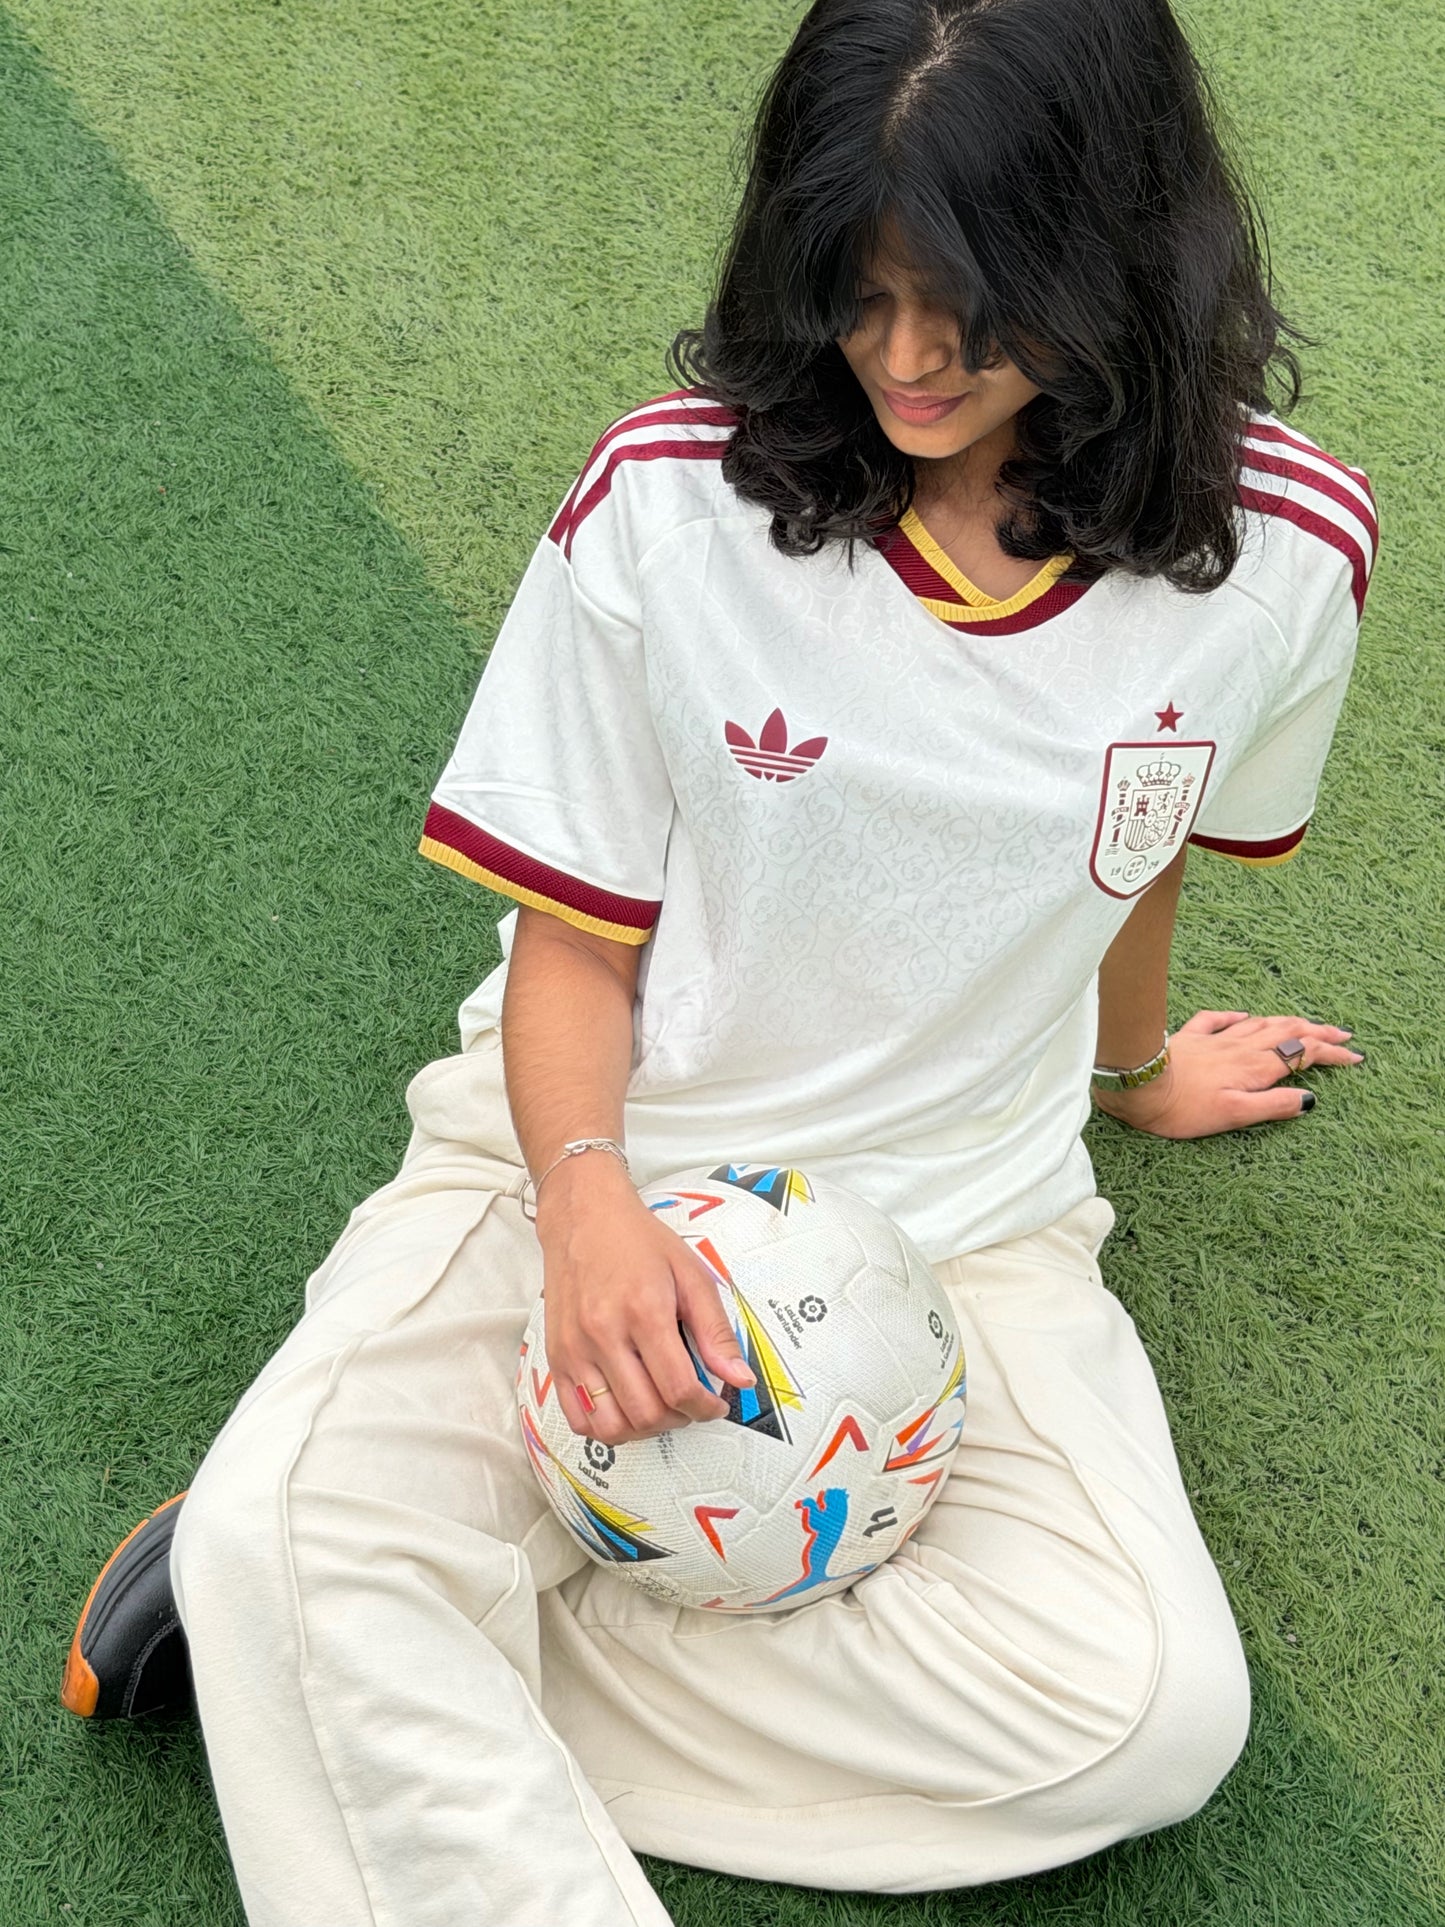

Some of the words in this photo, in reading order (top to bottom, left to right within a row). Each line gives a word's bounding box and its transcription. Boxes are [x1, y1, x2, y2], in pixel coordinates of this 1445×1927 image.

[773, 1307, 802, 1350] Santander
[783, 1304, 804, 1333] LaLiga
[577, 1460, 609, 1490] LaLiga
